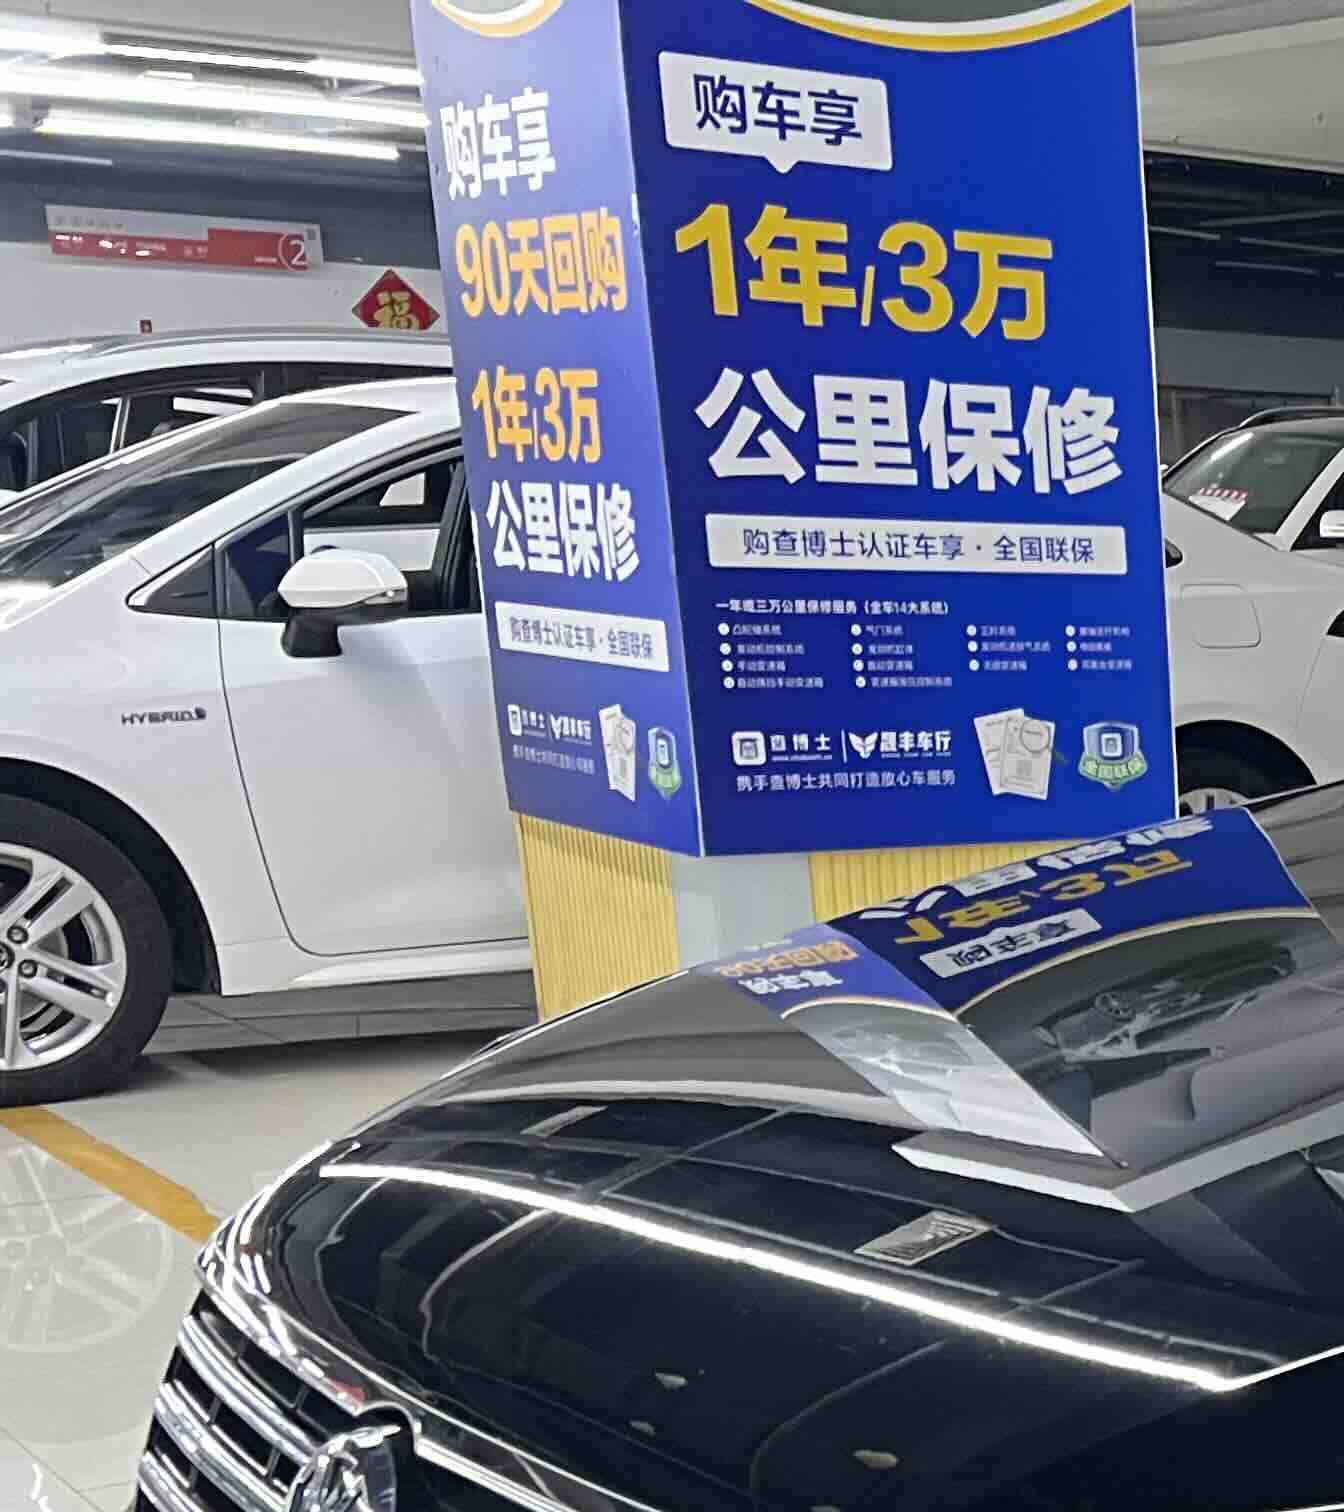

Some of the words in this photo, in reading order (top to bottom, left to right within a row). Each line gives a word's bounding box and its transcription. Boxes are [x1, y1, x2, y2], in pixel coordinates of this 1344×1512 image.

[441, 88, 555, 199] 购车享
[692, 75, 862, 146] 购车享
[455, 208, 628, 317] 90天回购
[675, 204, 1053, 340] 1年/3万
[473, 367, 601, 462] 1年/3万
[694, 365, 1123, 492] 公里保修
[486, 480, 641, 582] 公里保修
